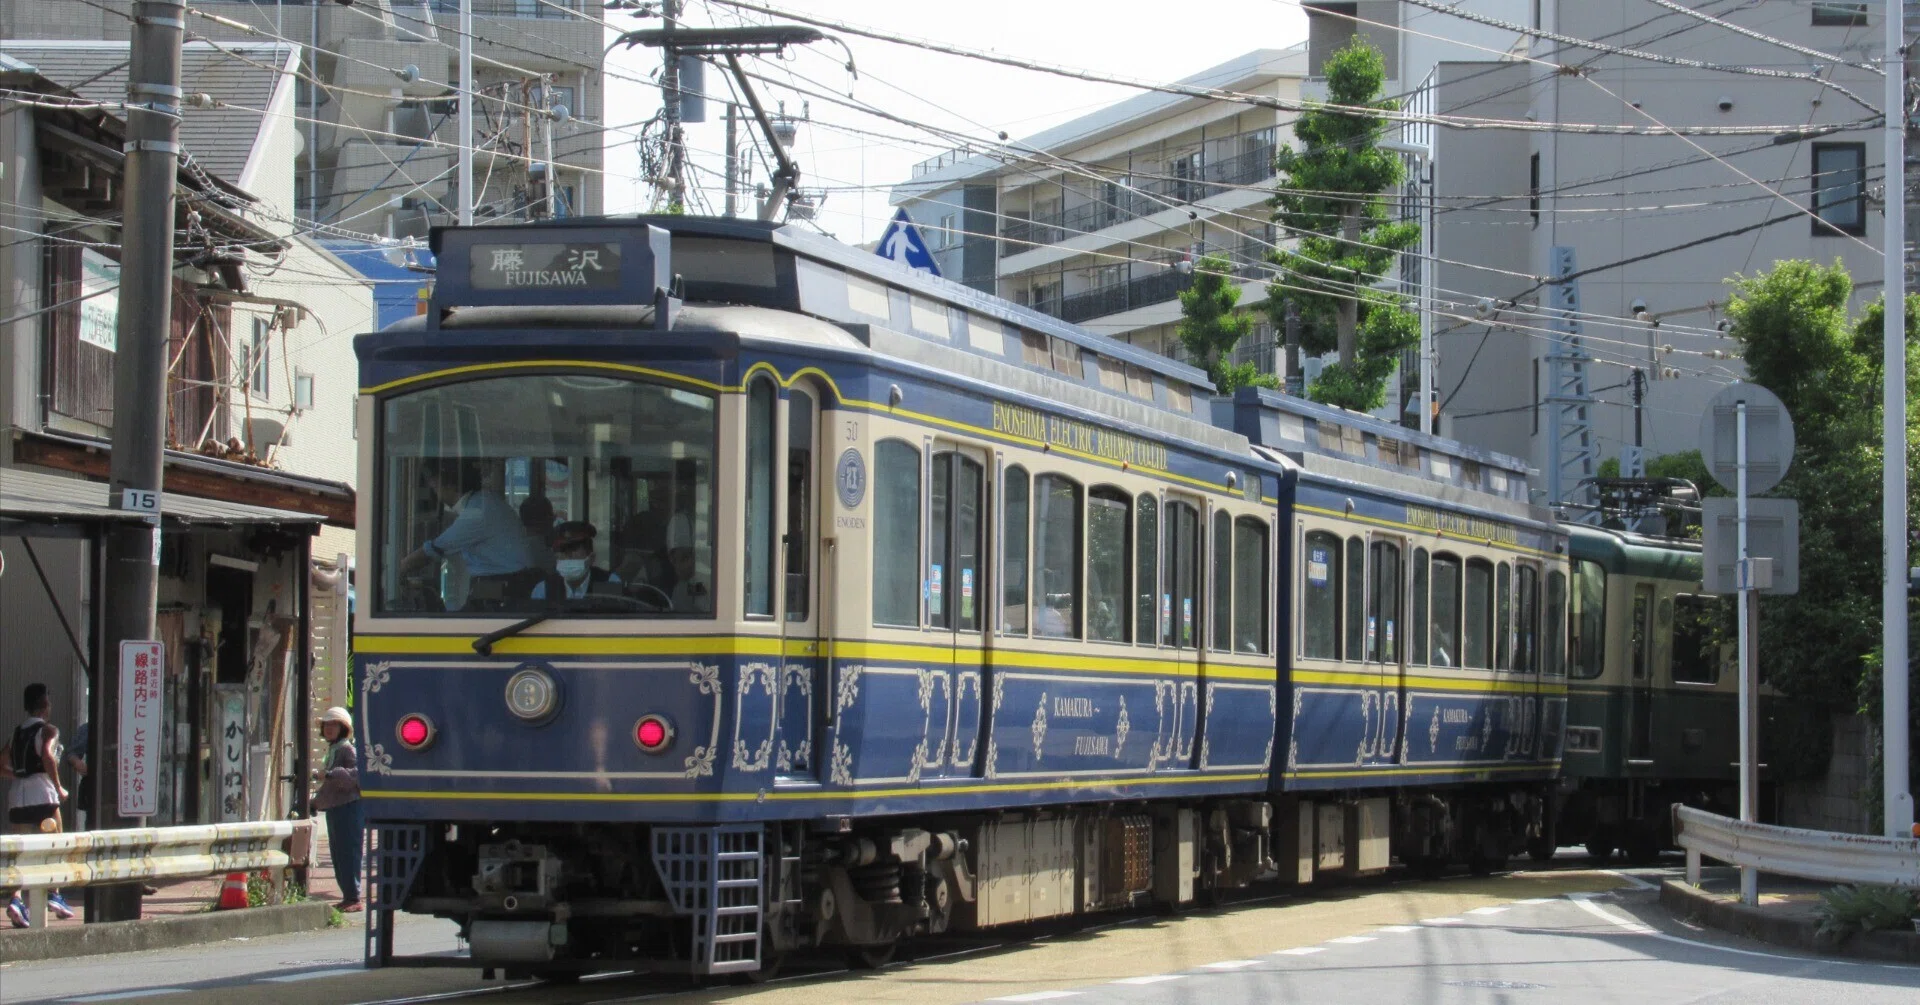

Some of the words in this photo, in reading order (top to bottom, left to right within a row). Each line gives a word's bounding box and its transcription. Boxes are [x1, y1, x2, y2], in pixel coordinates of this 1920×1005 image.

[490, 249, 602, 271] 藤沢
[505, 270, 587, 285] FUJISAWA
[993, 401, 1047, 442] ENOSHIMA
[1050, 415, 1095, 453] ELECTRIC
[1097, 427, 1135, 463] RAILWAY
[131, 492, 155, 509] 15
[837, 516, 865, 529] ENODEN
[134, 652, 149, 718] 線路内に
[1054, 697, 1092, 717] KAMAKURA
[1075, 736, 1108, 755] FUJISAWA
[132, 727, 145, 808] とまらない
